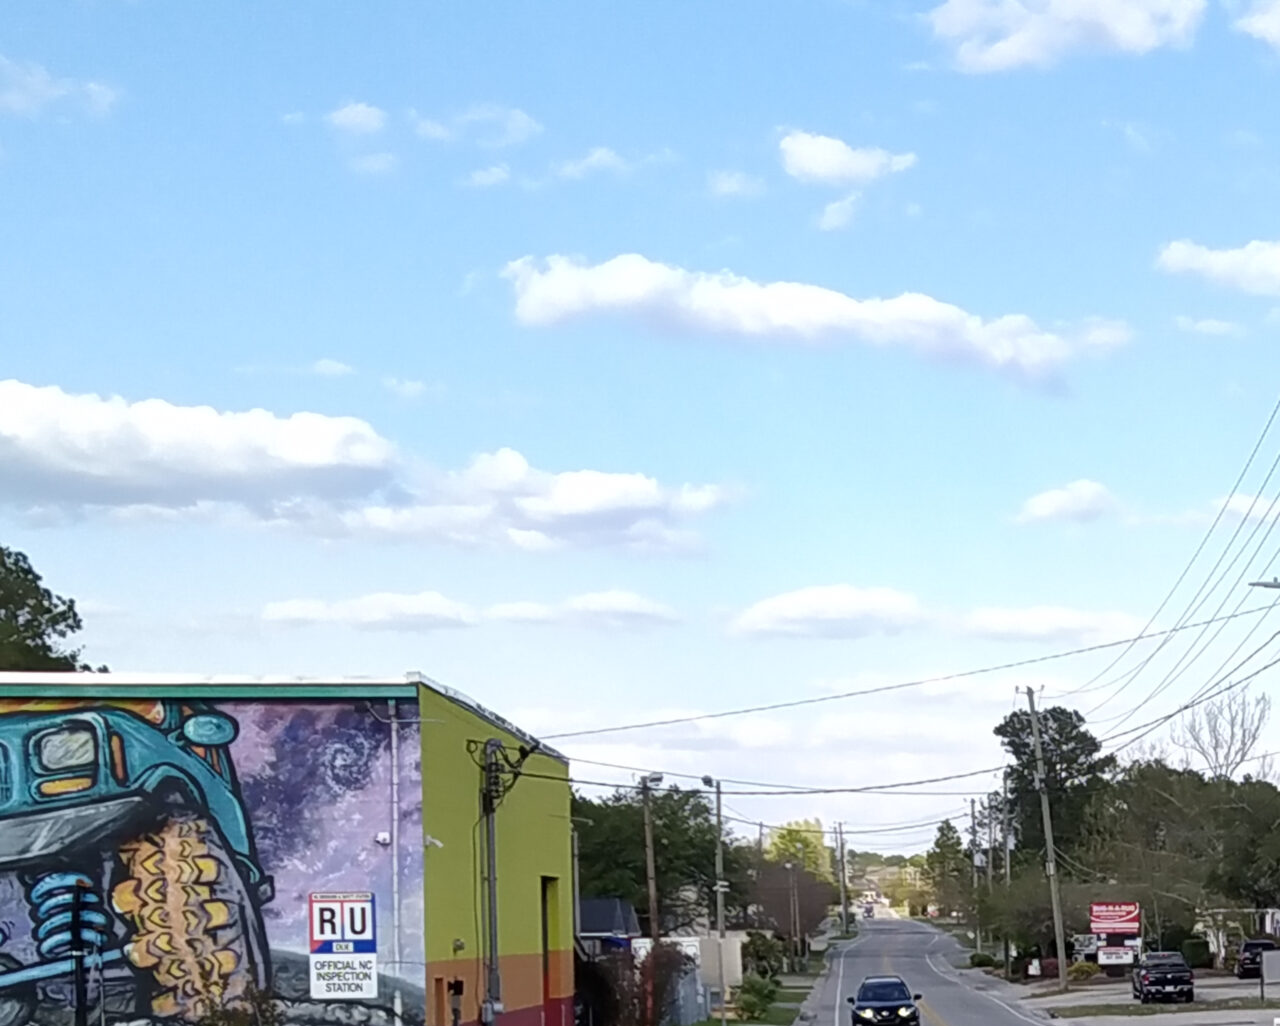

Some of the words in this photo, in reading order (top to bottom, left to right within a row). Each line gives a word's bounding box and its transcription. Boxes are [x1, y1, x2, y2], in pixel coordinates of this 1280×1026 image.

[314, 960, 357, 971] OFFICIAL
[359, 960, 373, 971] NC
[316, 971, 372, 981] INSPECTION
[325, 982, 363, 993] STATION
